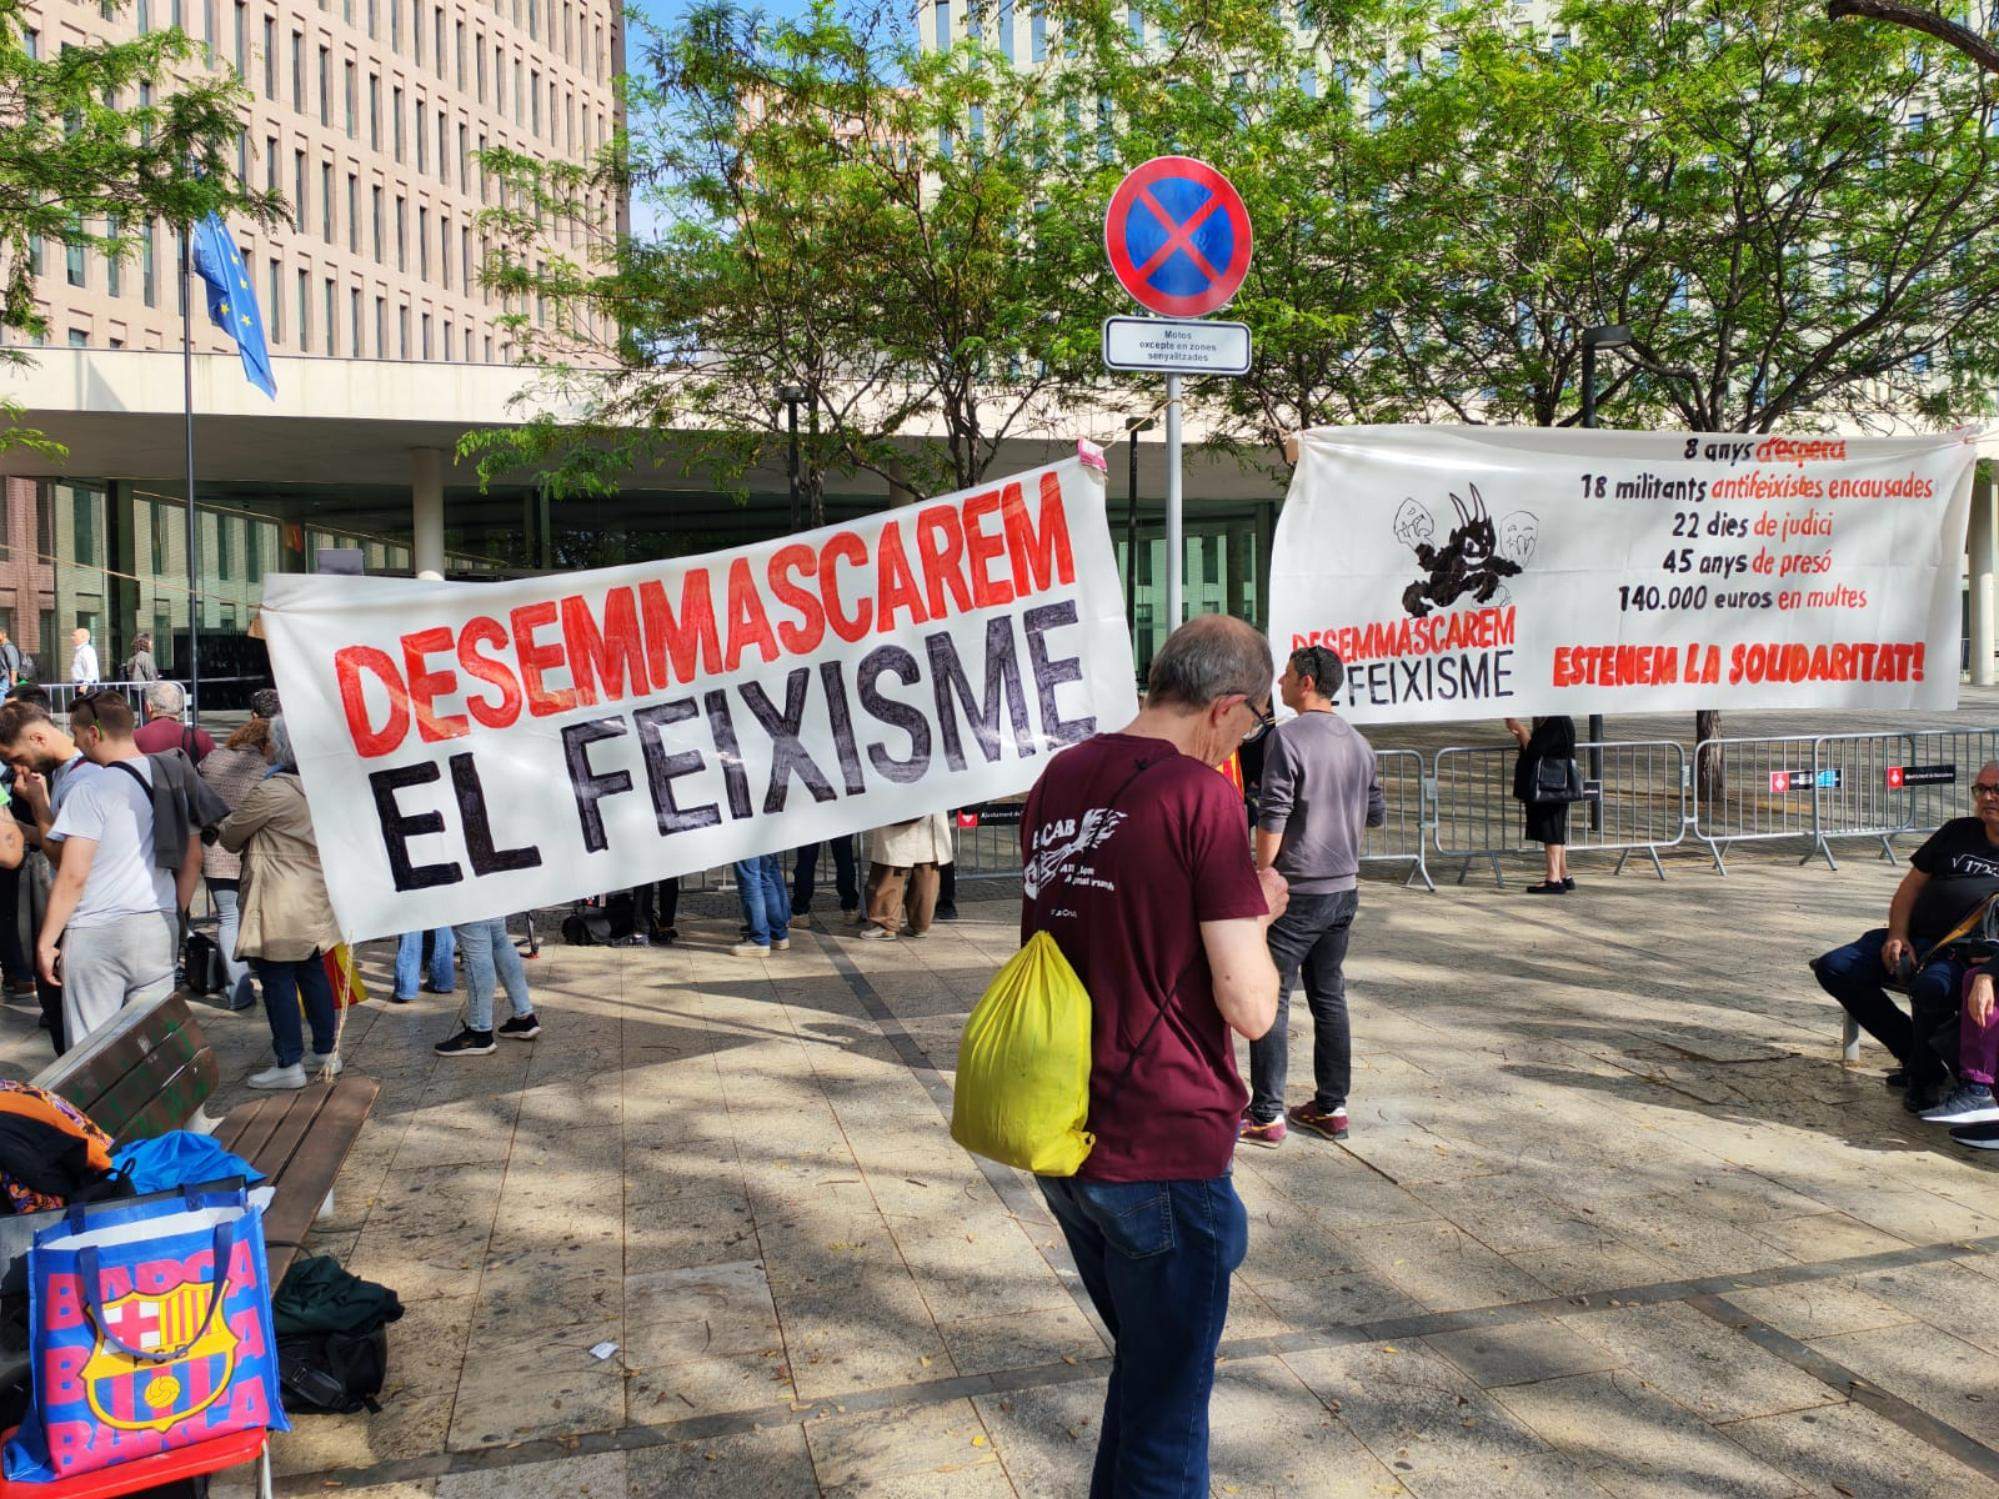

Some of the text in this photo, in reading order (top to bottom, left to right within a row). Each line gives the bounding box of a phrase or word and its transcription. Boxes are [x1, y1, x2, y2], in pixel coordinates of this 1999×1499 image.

[1165, 330, 1192, 340] Motos
[1190, 343, 1217, 351] zones
[1684, 438, 1699, 459] 8
[1704, 442, 1754, 466] anys
[1581, 470, 1933, 502] 18 militants antifeixistes encausades
[1672, 508, 1834, 542] 22 dies de judici
[1662, 546, 1832, 579] 45 anys de presó
[1619, 583, 1868, 611] 140.000 euros en multes
[333, 471, 1076, 758] DESEMMASCAREM
[1347, 650, 1514, 707] FEIXISME
[1552, 645, 1678, 687] ESTENEM
[1684, 643, 1721, 685] LA
[369, 599, 1097, 892] EL FEIXISME
